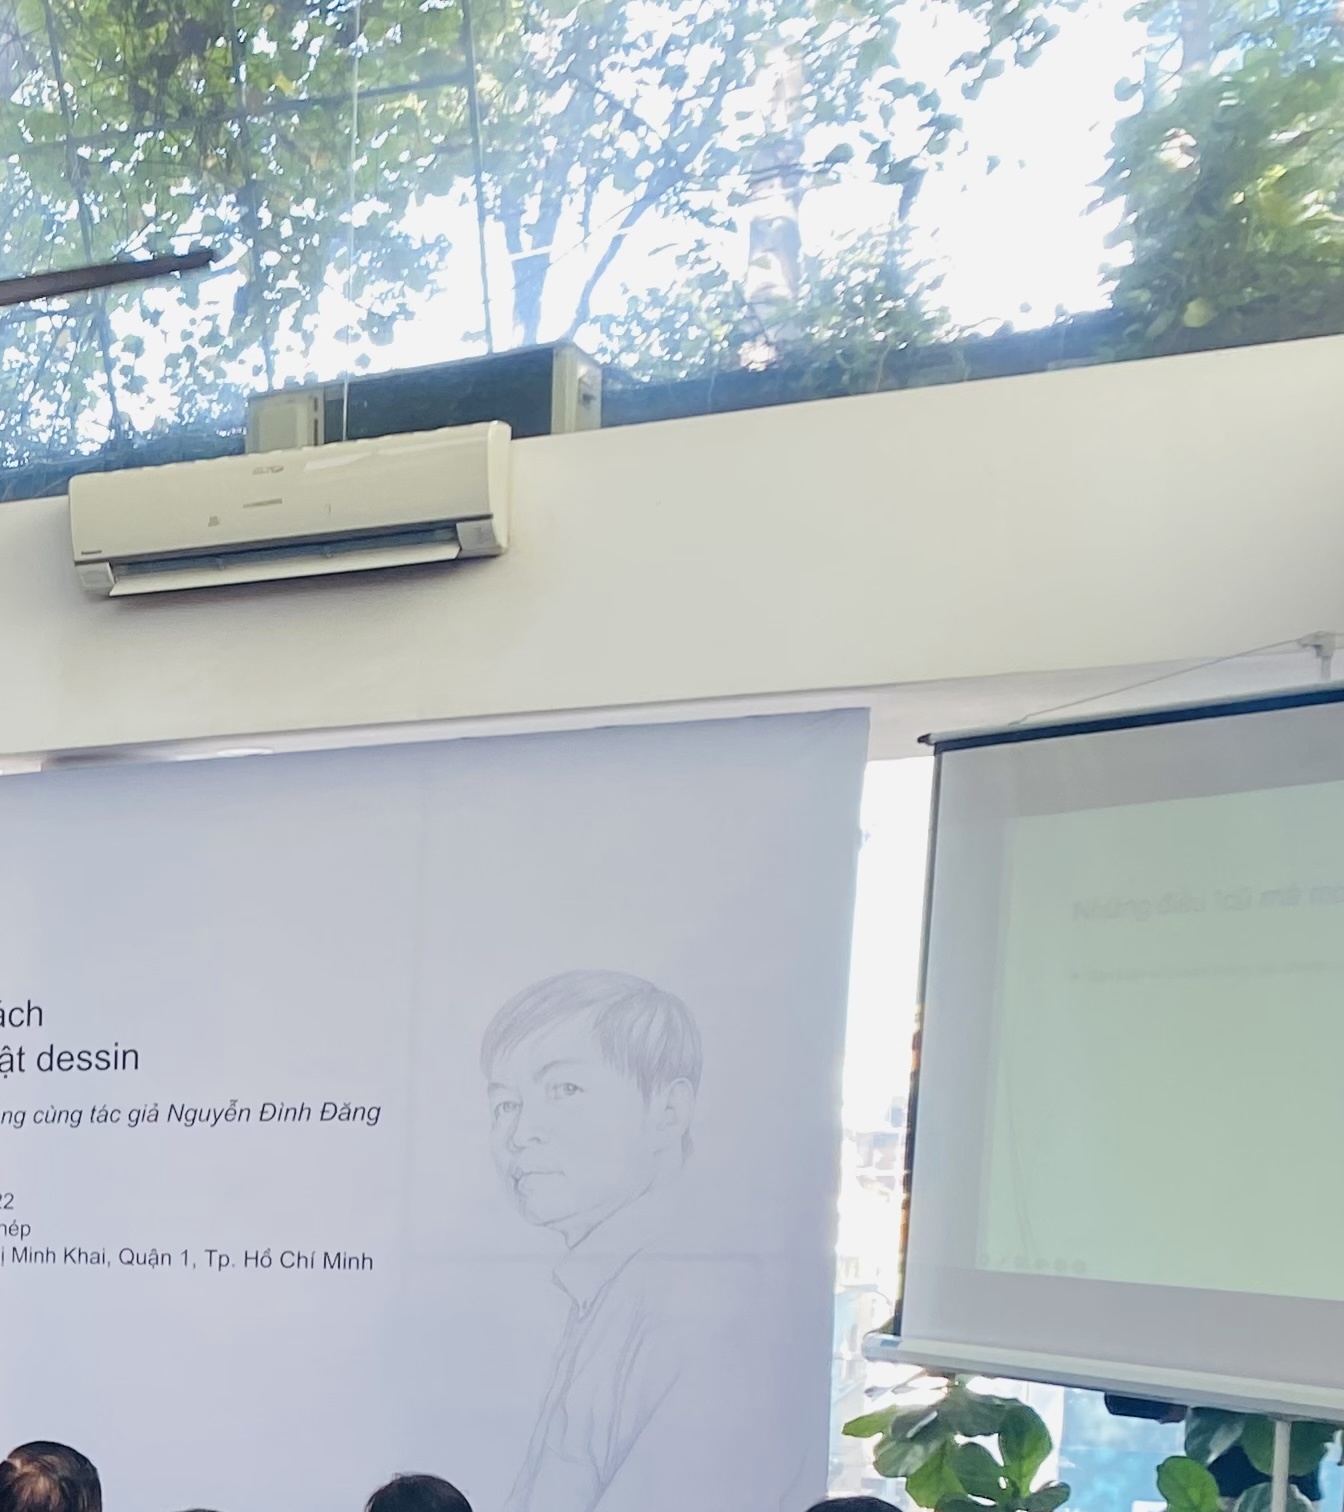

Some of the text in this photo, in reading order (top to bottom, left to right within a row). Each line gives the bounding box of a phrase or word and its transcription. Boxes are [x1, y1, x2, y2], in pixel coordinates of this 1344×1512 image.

[37, 1042, 140, 1072] dessin
[33, 1105, 84, 1129] cùng
[90, 1104, 121, 1124] tác
[127, 1102, 160, 1128] giả
[166, 1099, 252, 1128] Nguyễn
[259, 1101, 312, 1123] Đình
[319, 1101, 382, 1127] Đăng
[11, 1246, 56, 1265] Minh
[63, 1246, 112, 1268] Khai,
[119, 1247, 172, 1270] Quận
[180, 1248, 197, 1269] 1,
[204, 1249, 236, 1272] Tp.
[244, 1247, 273, 1269] Hồ
[280, 1250, 316, 1269] Chí
[323, 1251, 374, 1271] Minh
